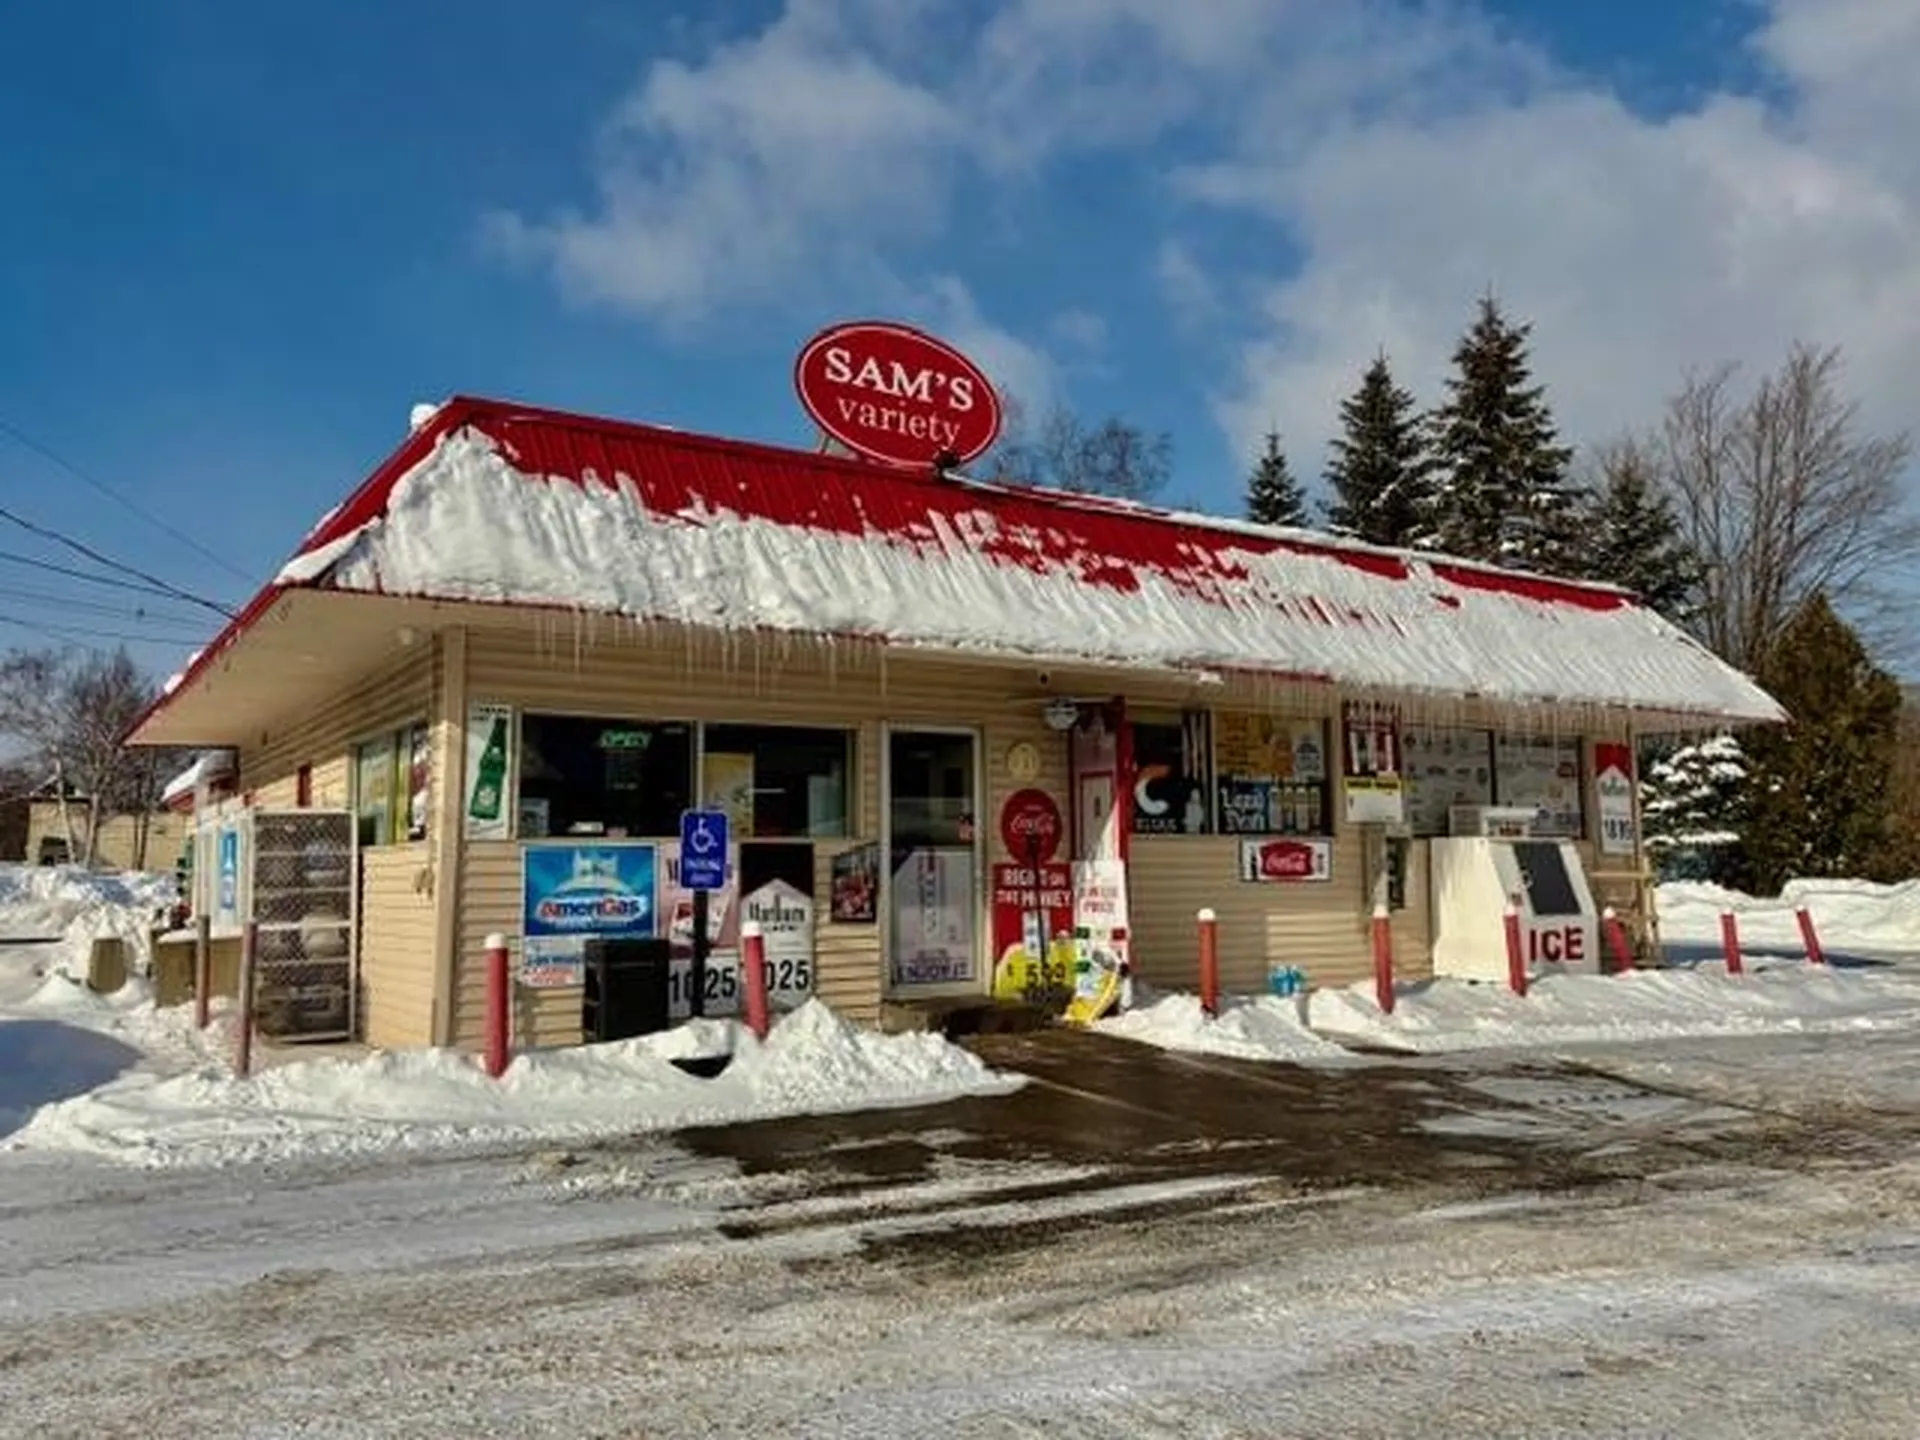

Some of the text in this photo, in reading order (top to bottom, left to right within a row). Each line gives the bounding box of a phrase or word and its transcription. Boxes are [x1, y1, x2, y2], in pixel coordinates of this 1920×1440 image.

[825, 347, 974, 411] SAM'S
[838, 396, 961, 451] variety
[1021, 889, 1072, 908] MNEY
[1529, 925, 1584, 962] ICE
